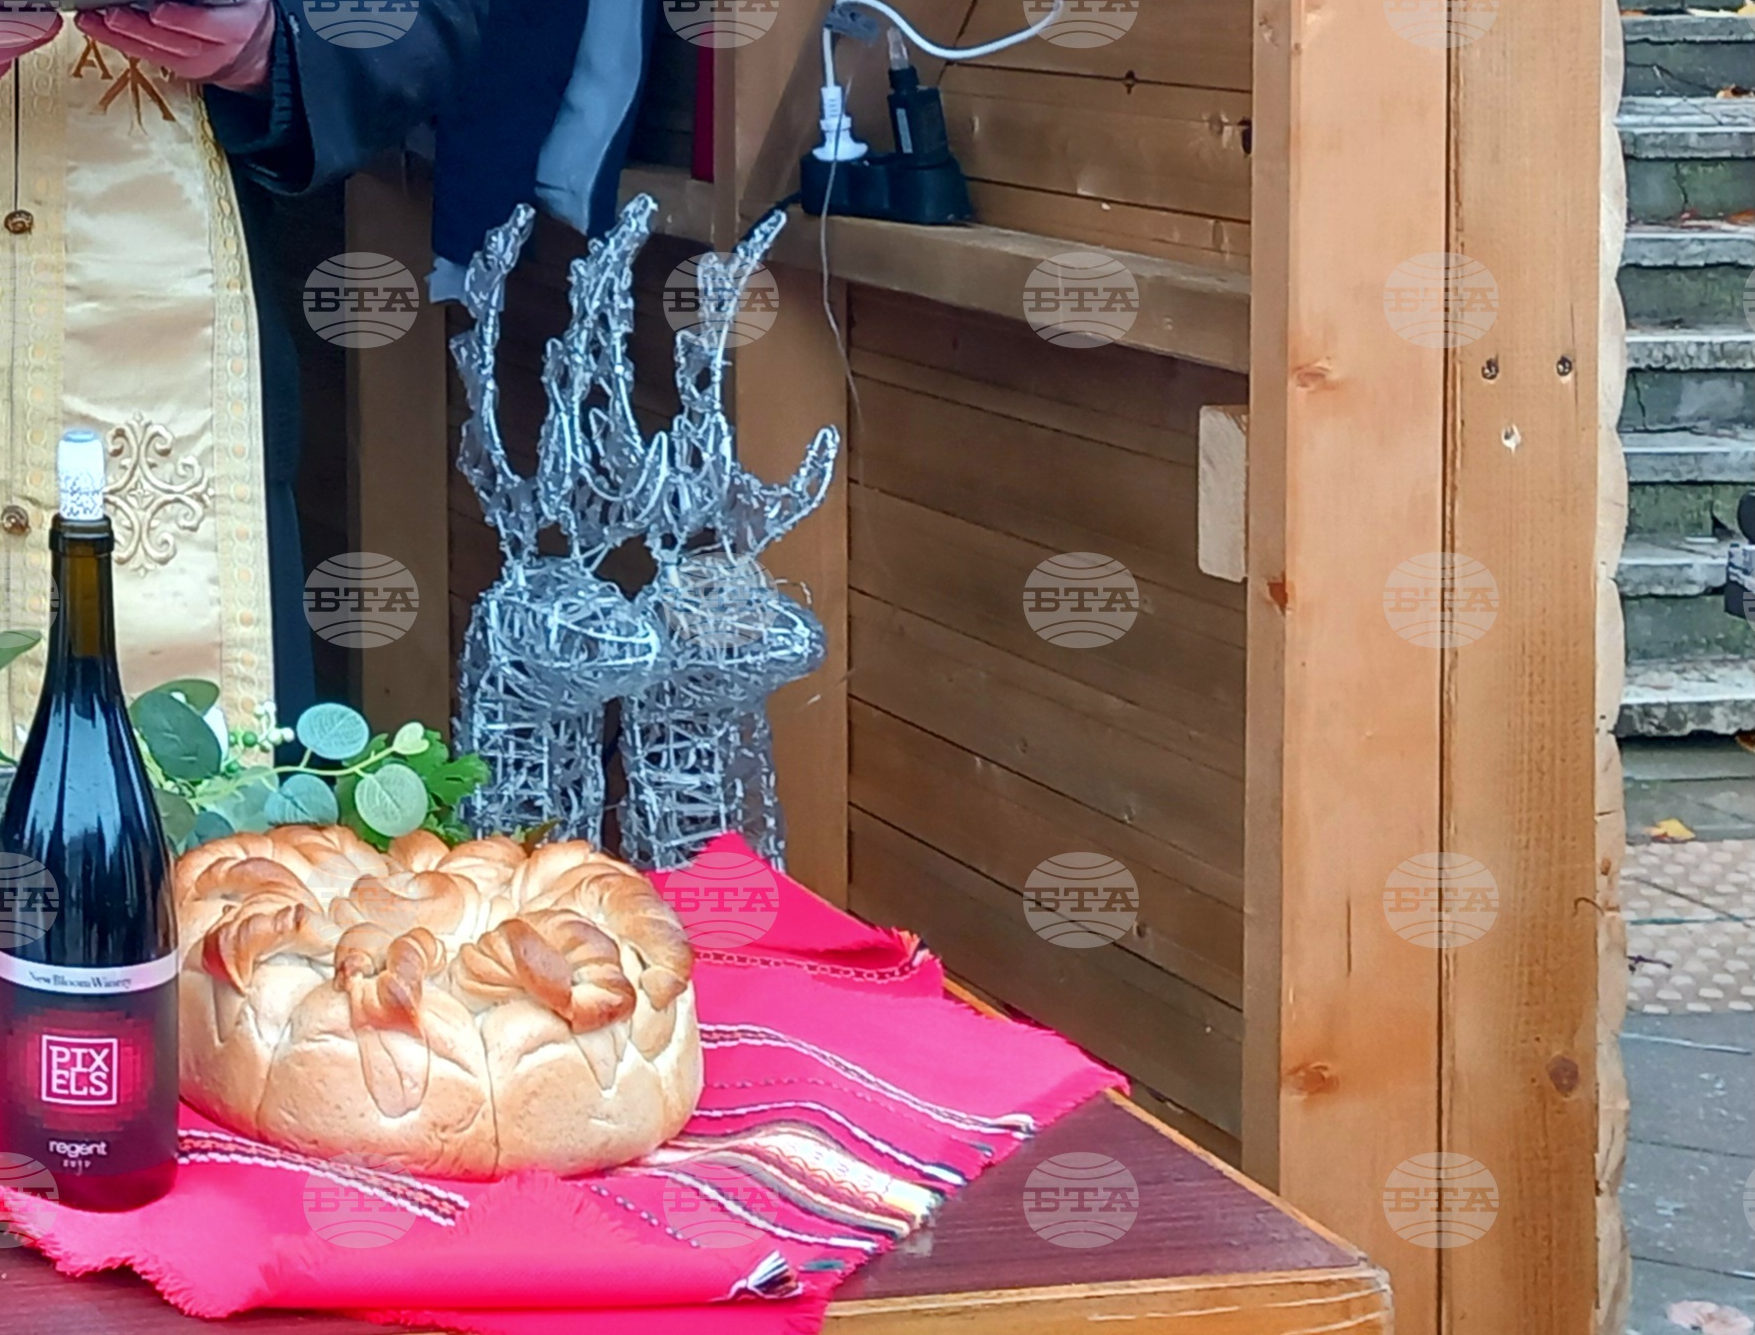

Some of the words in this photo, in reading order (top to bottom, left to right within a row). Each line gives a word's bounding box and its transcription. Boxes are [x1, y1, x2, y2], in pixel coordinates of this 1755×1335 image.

[29, 970, 51, 984] New
[52, 974, 91, 988] Bloom
[91, 976, 132, 990] Winery
[49, 1045, 110, 1073] PIX
[51, 1069, 108, 1096] ELS
[49, 1140, 108, 1158] regent
